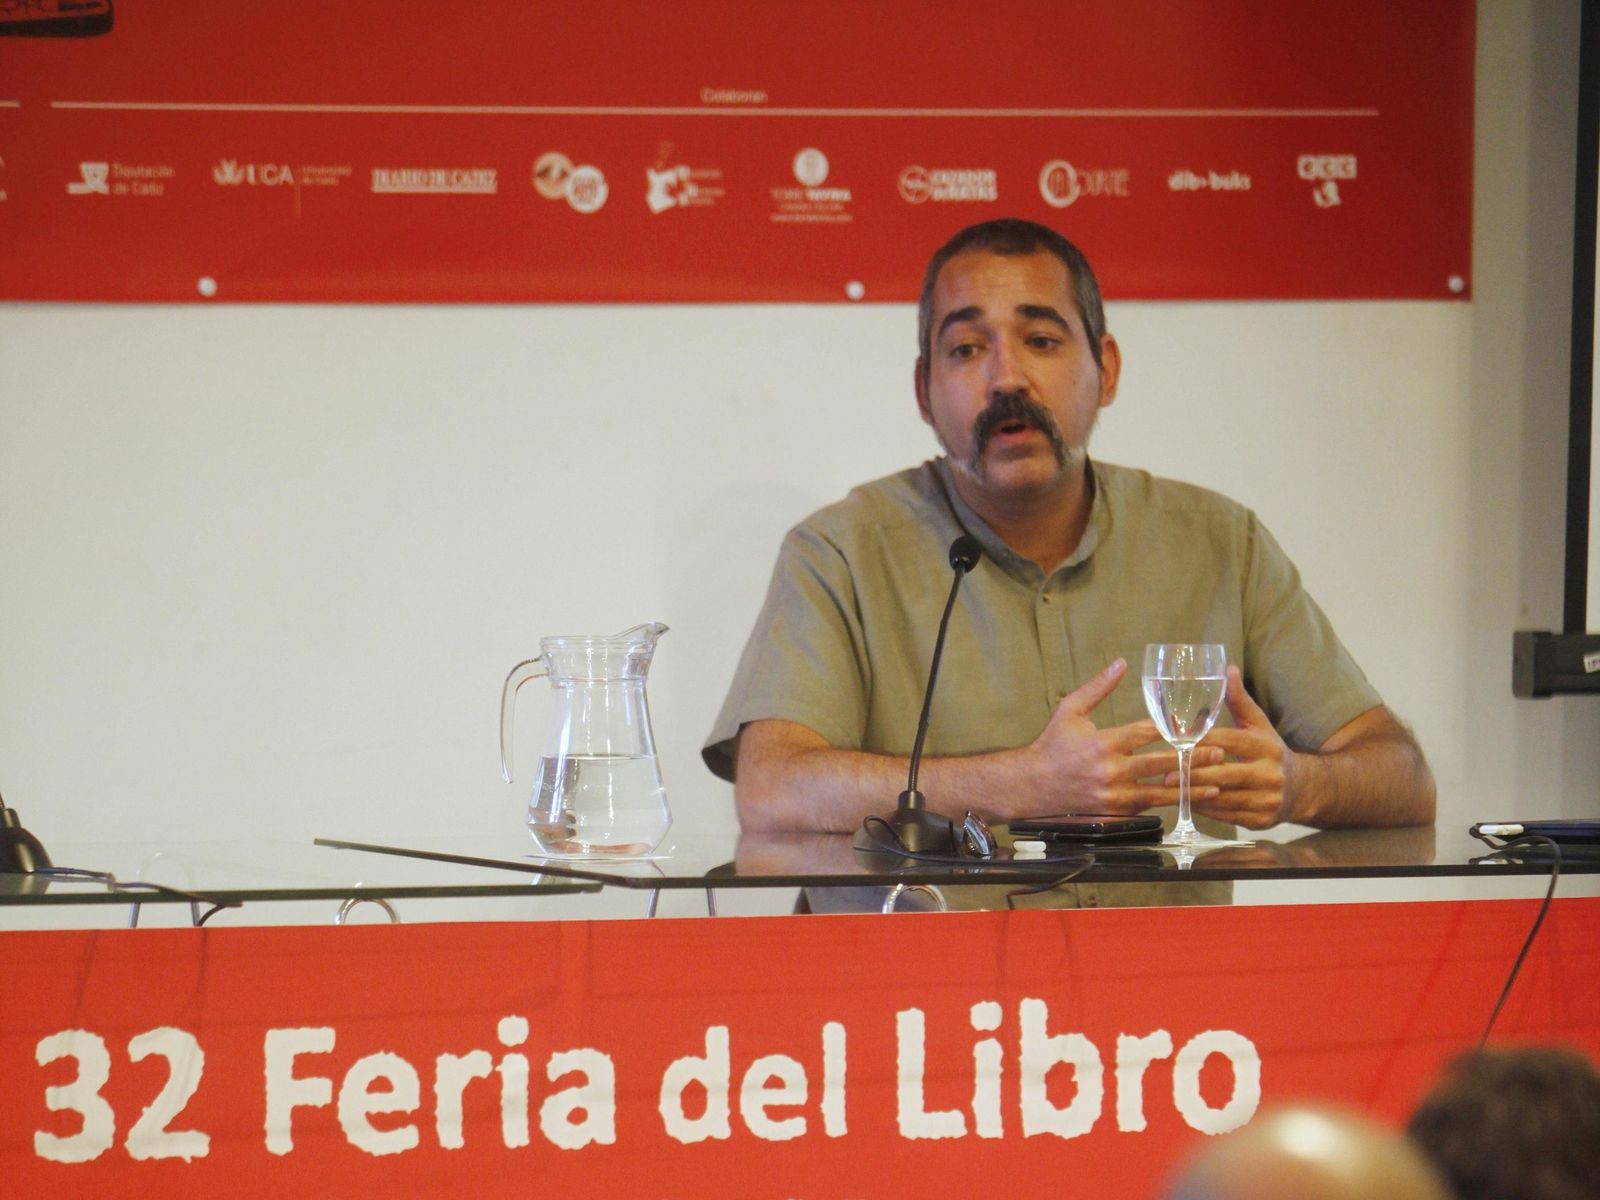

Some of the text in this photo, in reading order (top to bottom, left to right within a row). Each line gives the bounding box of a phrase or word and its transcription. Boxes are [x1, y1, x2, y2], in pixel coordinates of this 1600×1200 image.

[34, 997, 1262, 1164] 32 Feria del Libro
